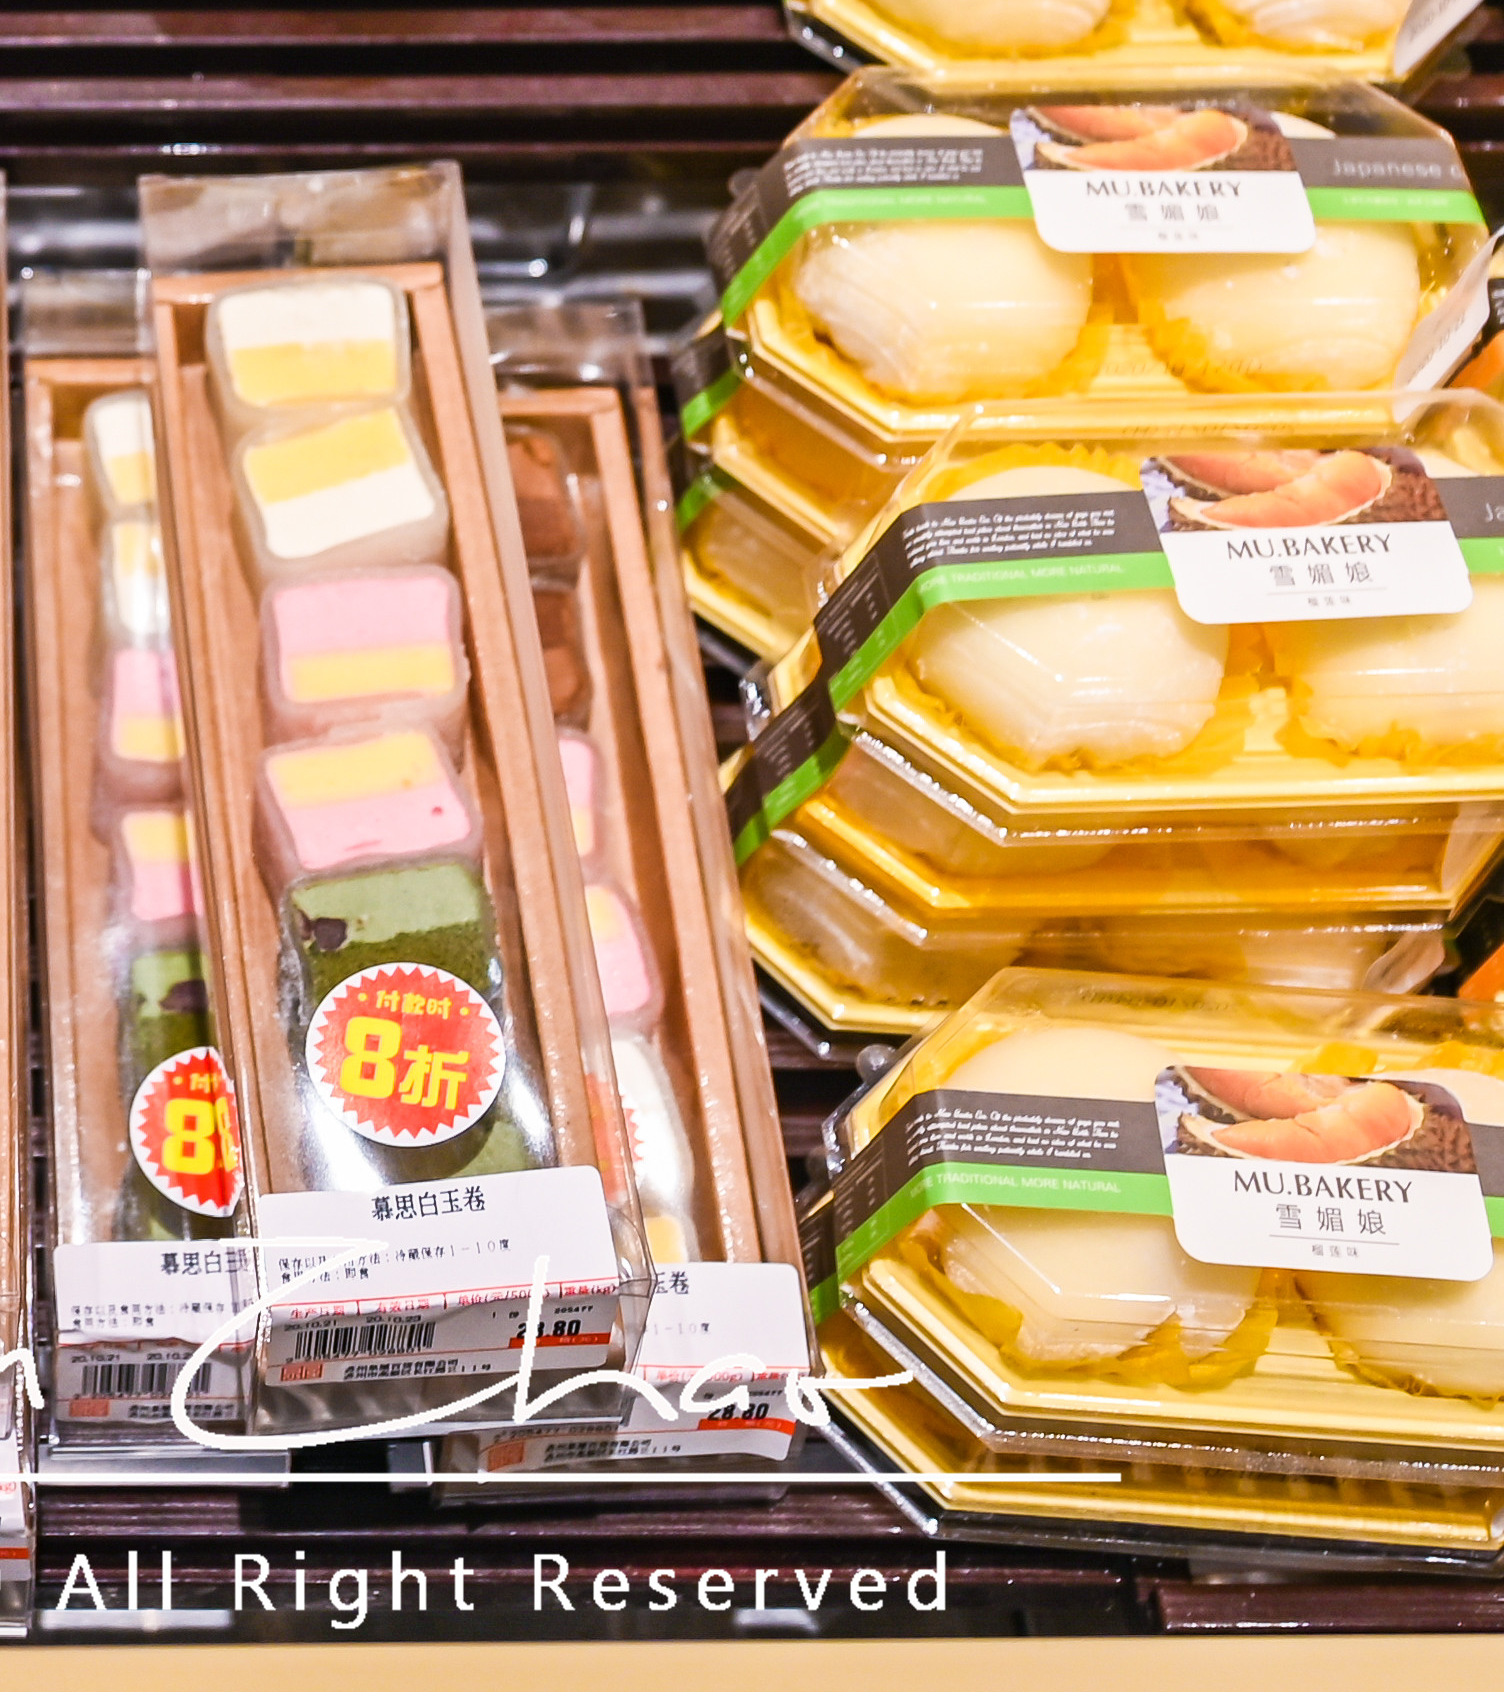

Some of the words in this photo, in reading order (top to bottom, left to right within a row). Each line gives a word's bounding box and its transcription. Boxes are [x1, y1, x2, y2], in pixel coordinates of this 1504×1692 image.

[1331, 156, 1445, 181] Japanese
[1085, 179, 1243, 199] MU.BAKERY
[1226, 533, 1394, 564] MU.BAKERY
[1267, 561, 1376, 590] 雪媚娘
[376, 990, 452, 1020] 付款时
[339, 1016, 469, 1112] 8折
[936, 1171, 1017, 1188] TRADITIONAL
[1020, 1176, 1060, 1190] MORE
[1062, 1180, 1122, 1194] NATURAL
[1231, 1170, 1414, 1205] MU.BAKERY
[371, 1185, 486, 1222] 慕思白玉卷
[1274, 1201, 1388, 1236] 雪媚娘
[1311, 1241, 1360, 1260] 榴莲味
